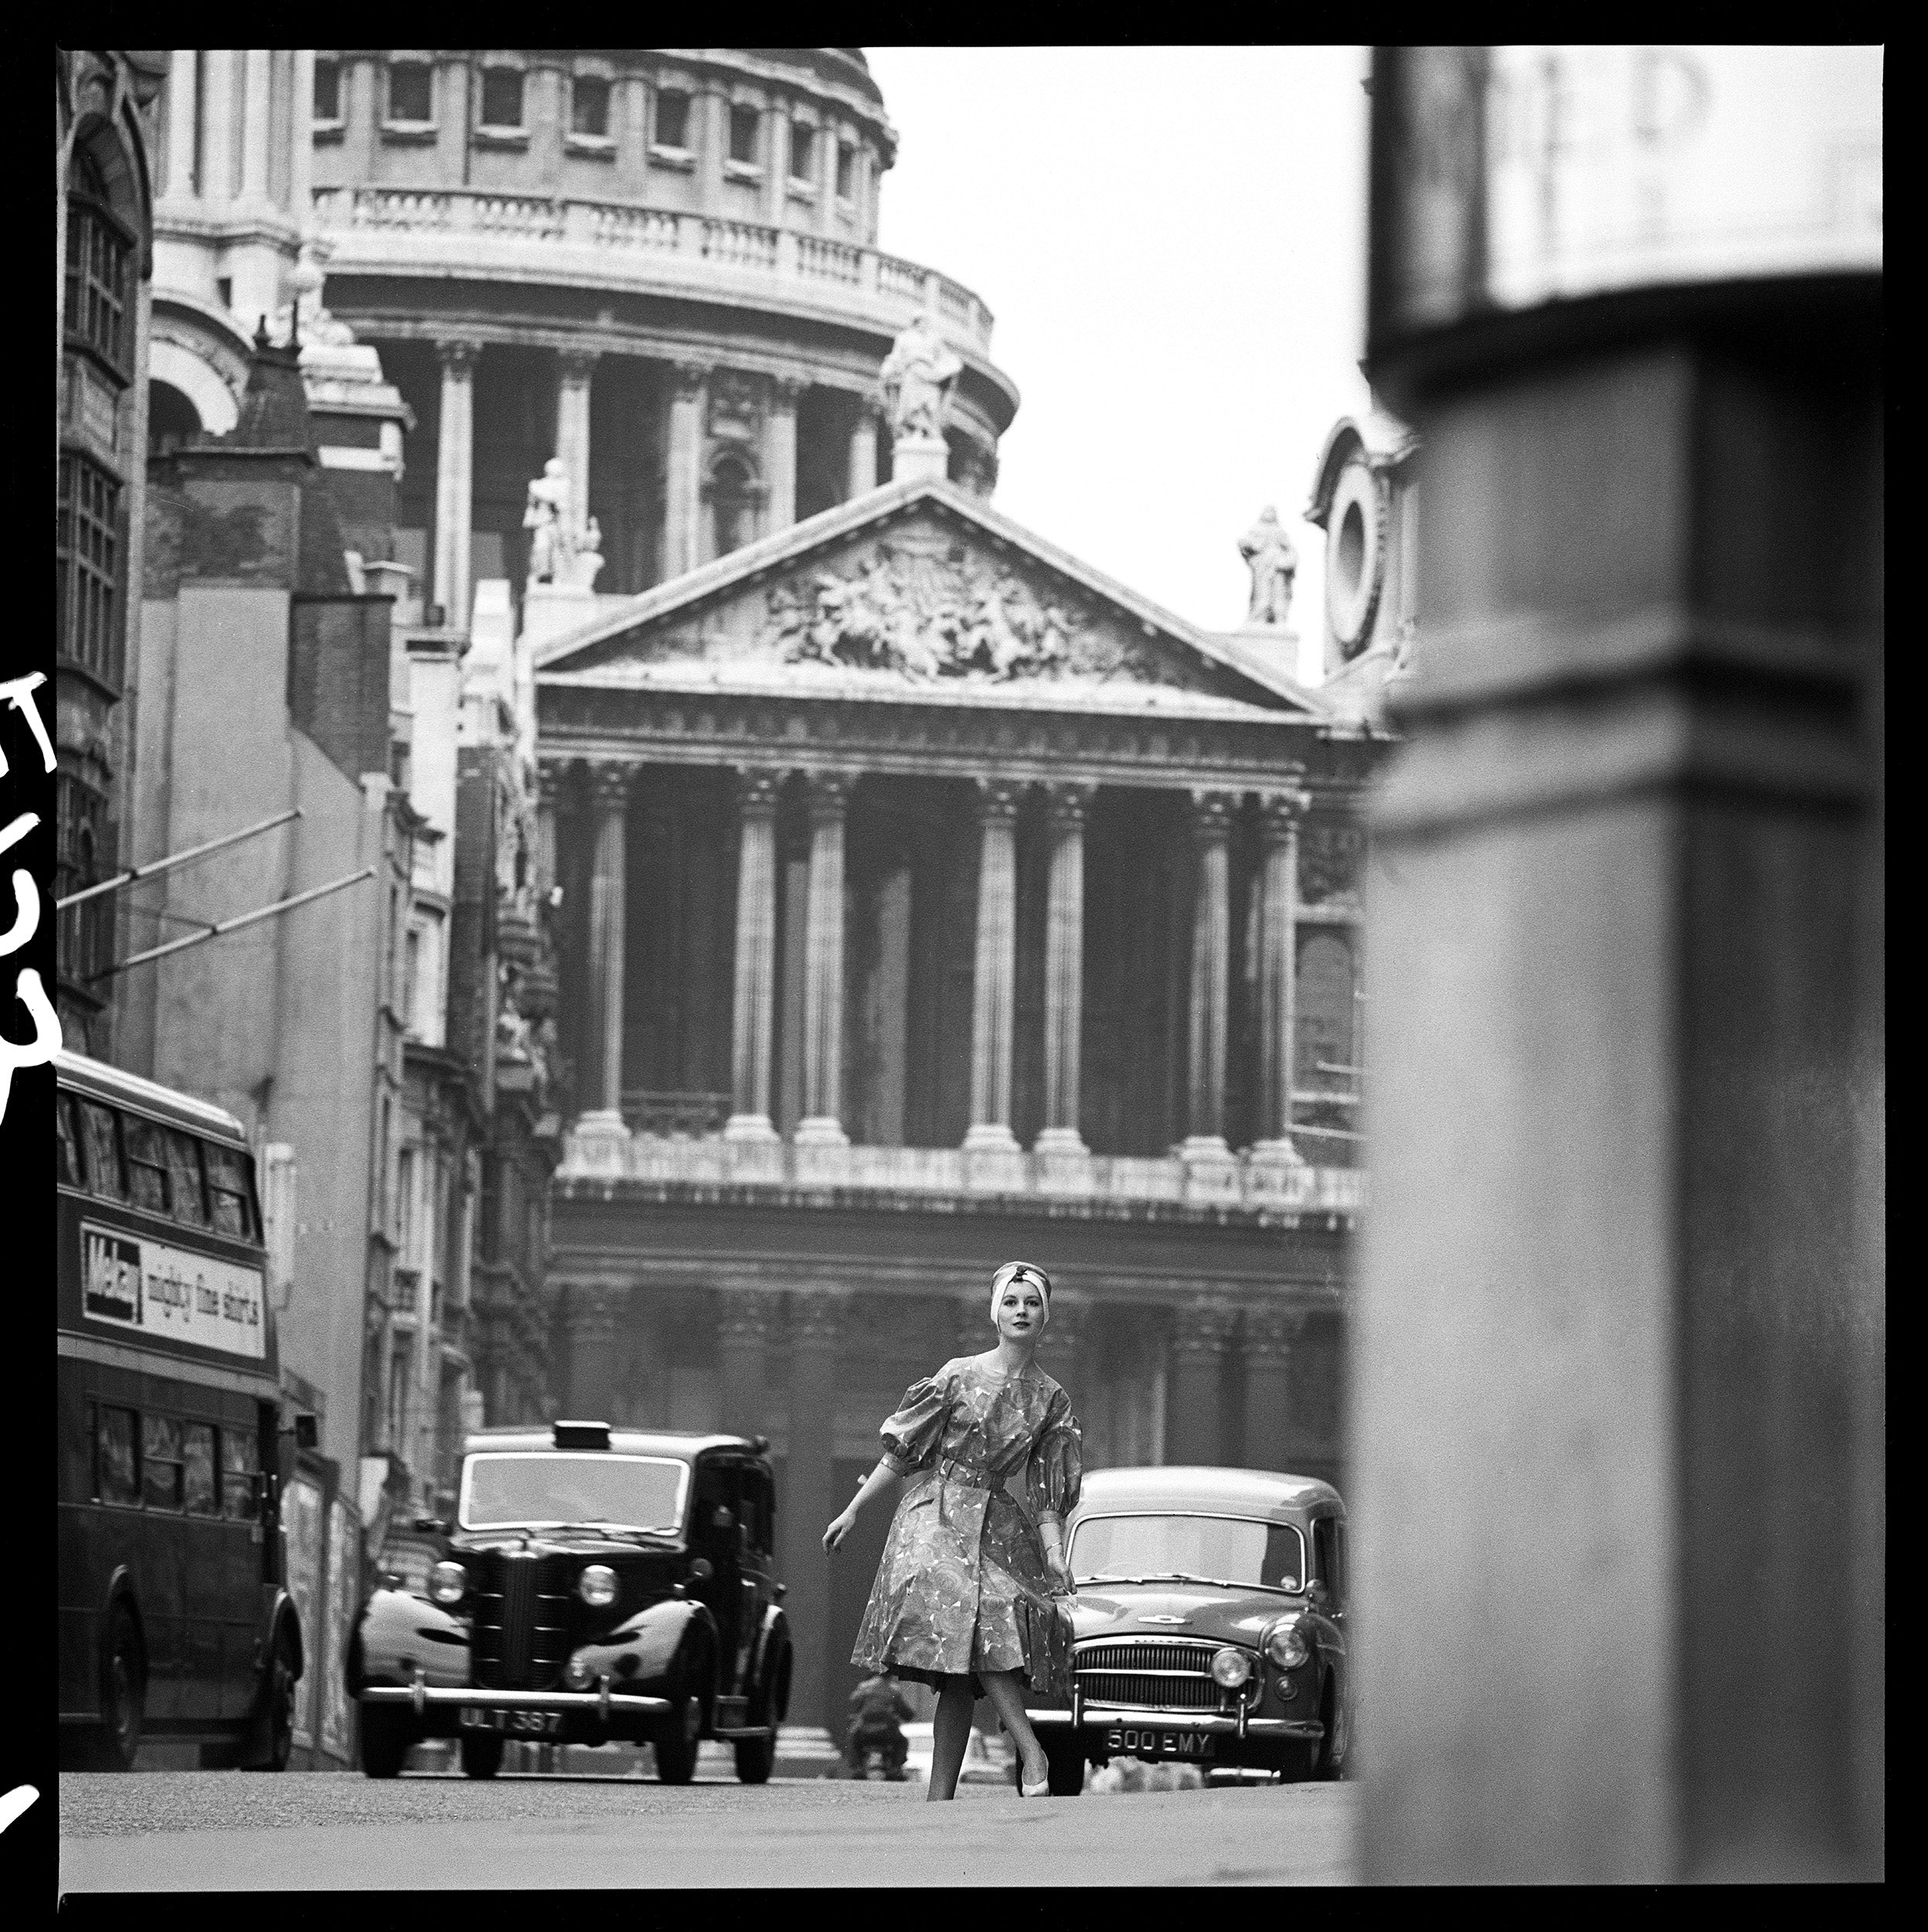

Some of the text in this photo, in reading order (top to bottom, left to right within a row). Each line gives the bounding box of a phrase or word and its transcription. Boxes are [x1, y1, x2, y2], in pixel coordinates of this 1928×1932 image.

[148, 1264, 259, 1326] mighty fine shirts
[461, 1707, 509, 1730] ULT
[1108, 1729, 1209, 1753] 500 EMY
